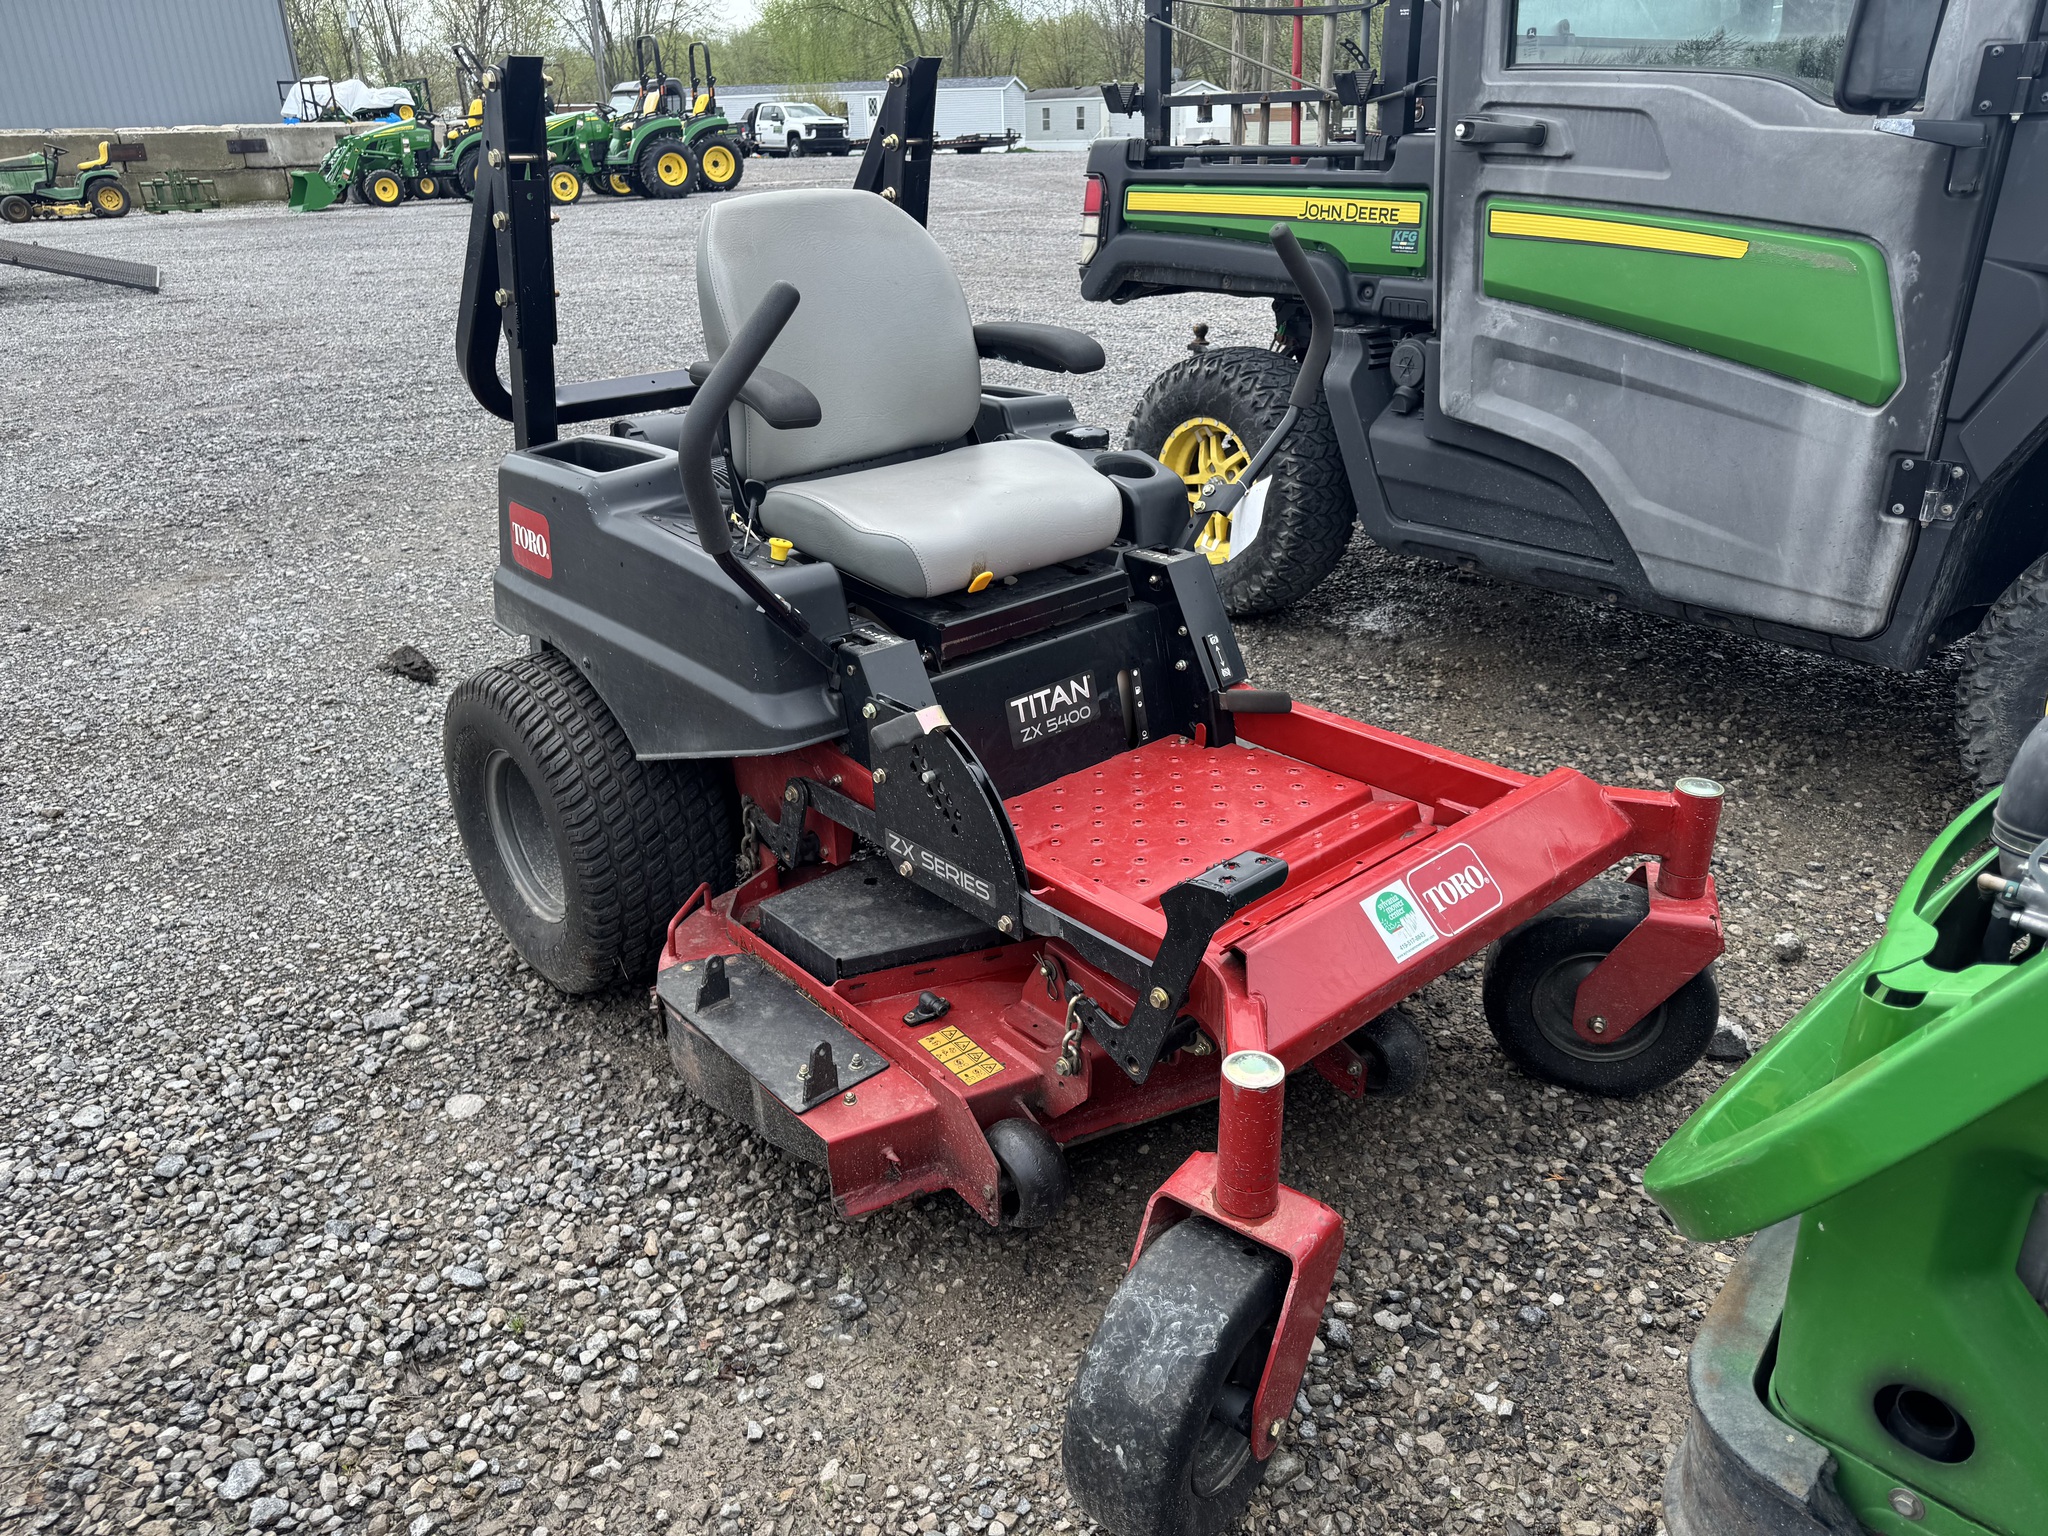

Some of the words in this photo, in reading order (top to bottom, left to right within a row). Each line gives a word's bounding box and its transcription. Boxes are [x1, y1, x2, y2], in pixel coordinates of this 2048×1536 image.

[1392, 230, 1418, 242] KFG
[511, 521, 548, 559] TORO
[1010, 675, 1090, 723] TITAN
[1020, 722, 1043, 743] ZX
[1046, 705, 1091, 733] 5400
[888, 833, 915, 861] ZX
[920, 850, 990, 901] SERIES
[1377, 893, 1400, 912] sylvania
[1385, 899, 1405, 914] mower
[1422, 865, 1488, 913] TORO
[1388, 906, 1406, 921] center
